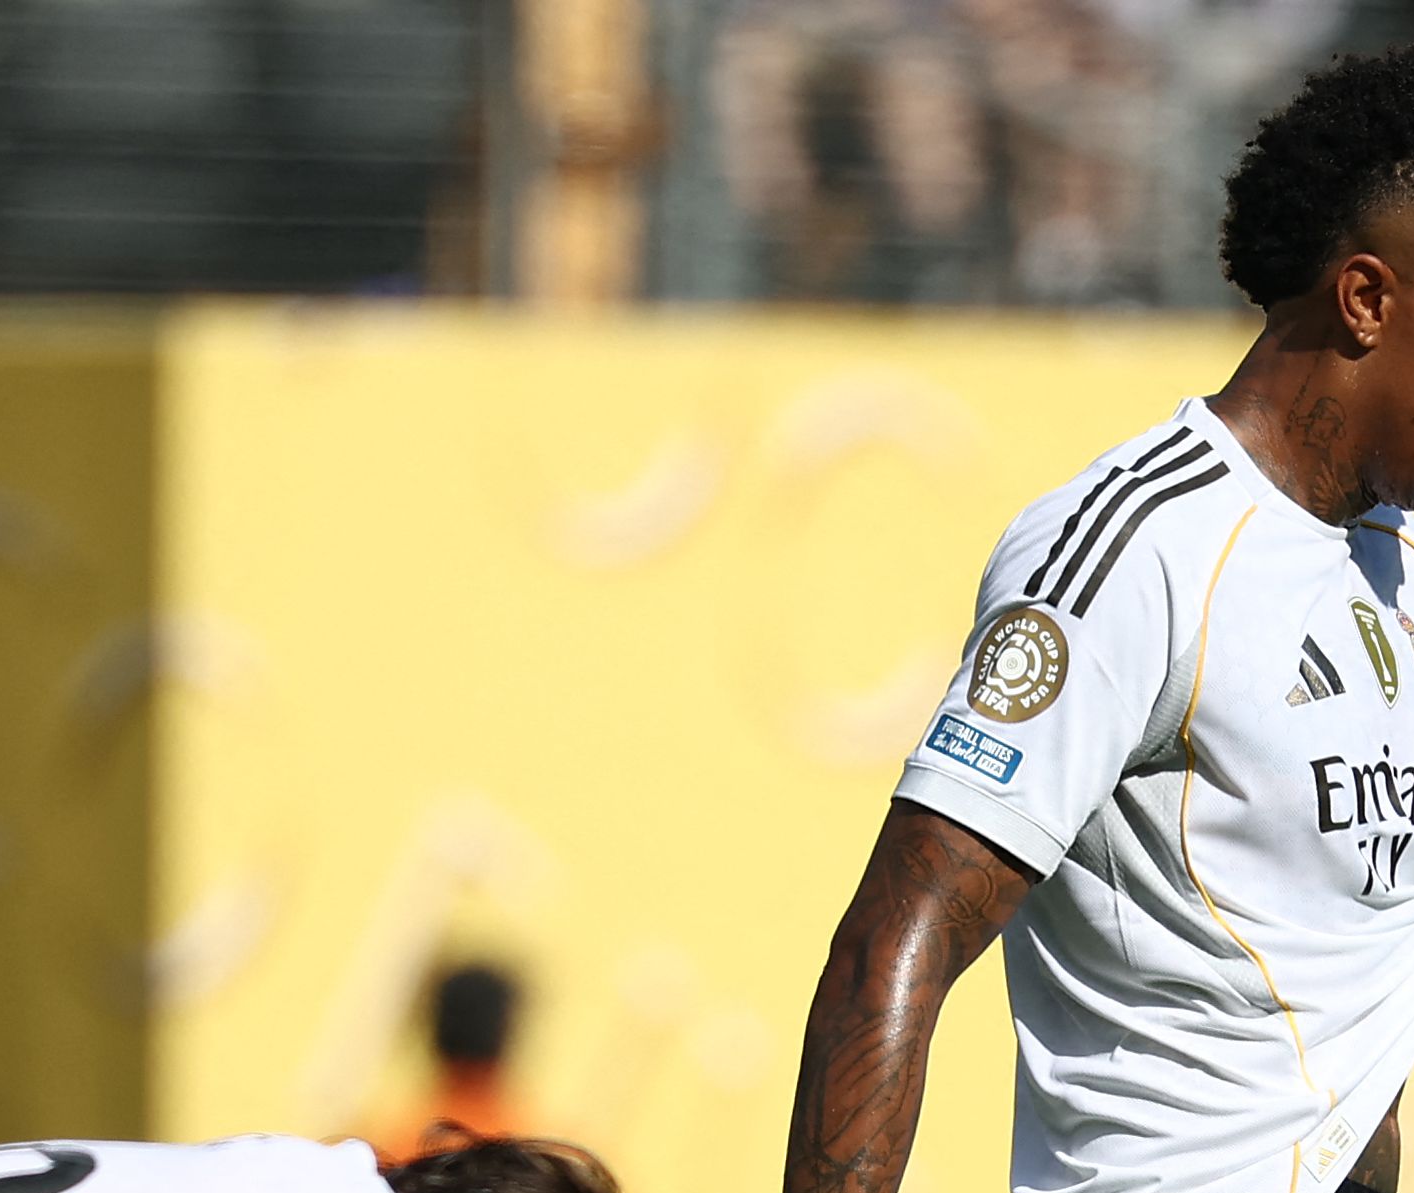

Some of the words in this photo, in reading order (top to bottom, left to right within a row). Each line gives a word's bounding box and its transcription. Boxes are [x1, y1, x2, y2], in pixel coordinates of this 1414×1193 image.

[994, 618, 1039, 642] WORLD
[1039, 631, 1059, 659] CUP
[1045, 664, 1059, 683] 25
[973, 684, 1010, 716] FIFA
[1020, 684, 1050, 708] USA
[979, 736, 1014, 763] UNITES
[981, 757, 1002, 774] FIFA
